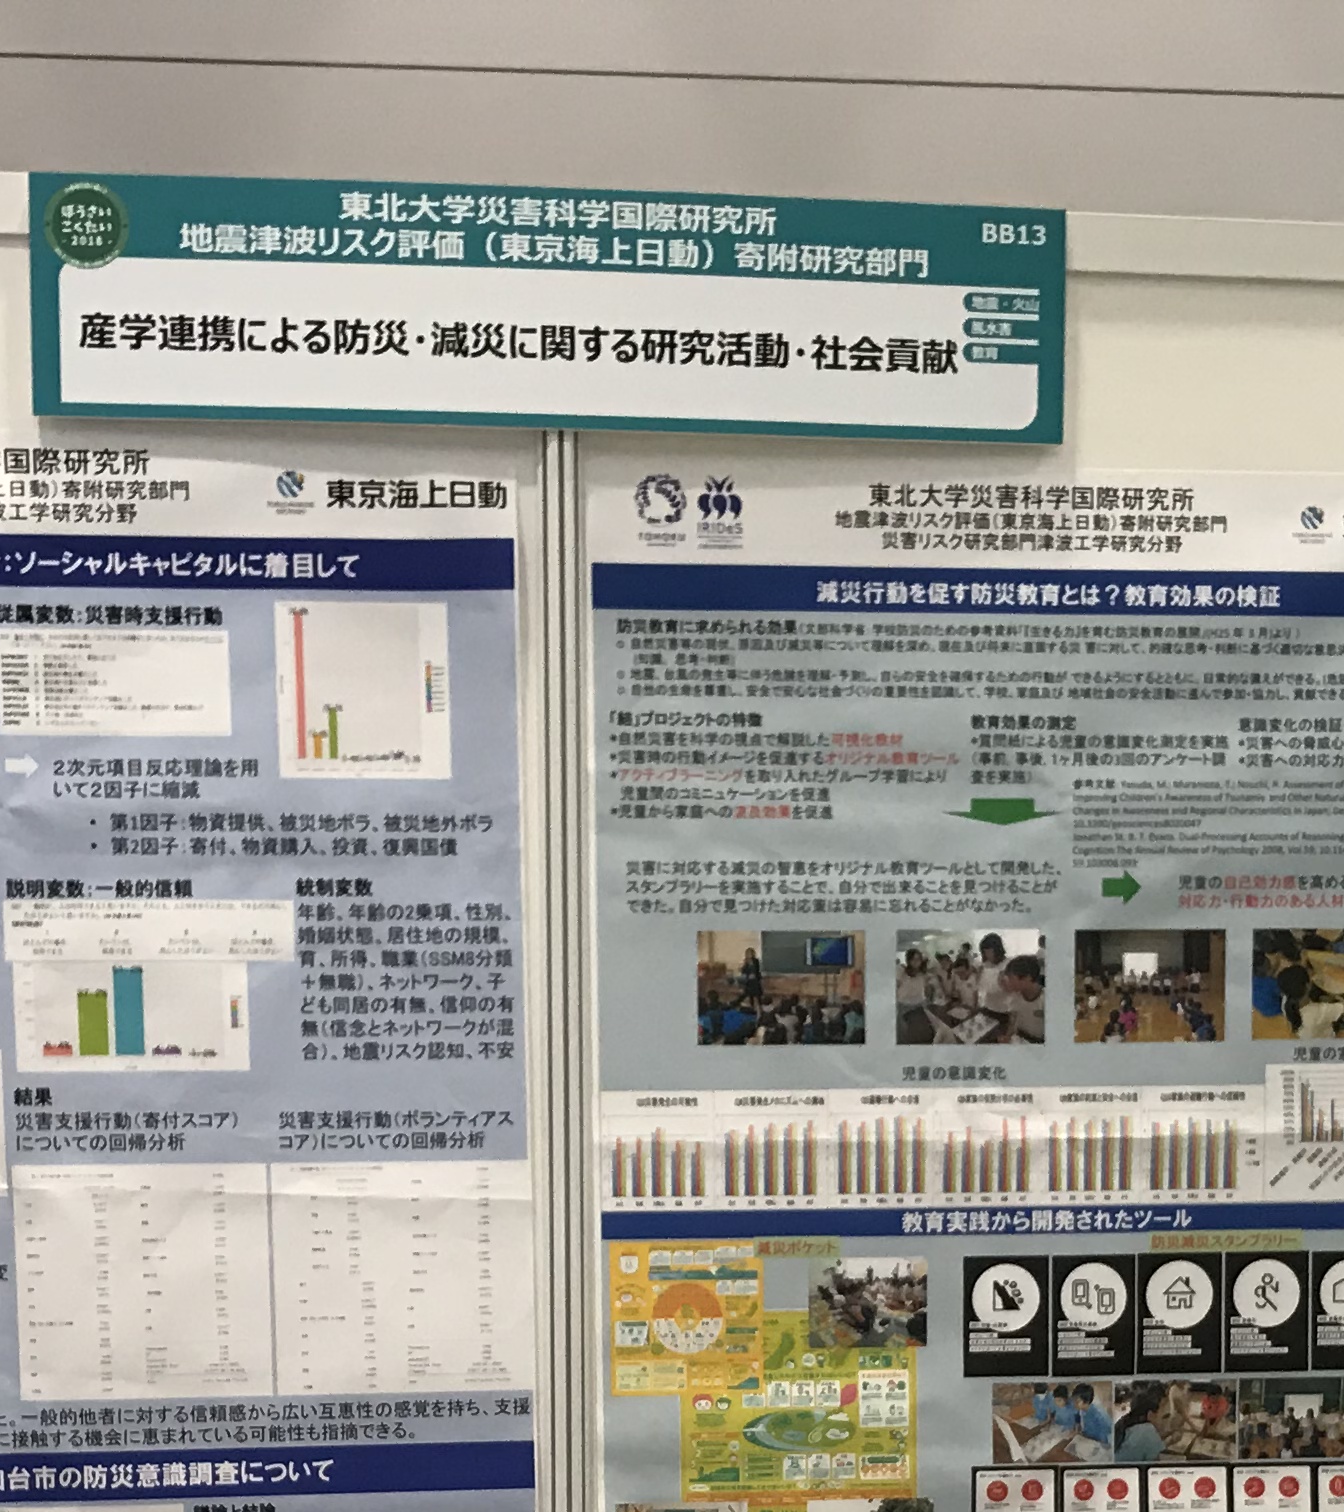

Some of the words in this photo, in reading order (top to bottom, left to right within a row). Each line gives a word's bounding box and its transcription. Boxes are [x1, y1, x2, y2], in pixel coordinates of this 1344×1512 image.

[338, 190, 778, 238] 東北大学災害科学国際研究所
[982, 223, 1047, 246] BB13
[179, 223, 930, 280] 地震津波リスク評価（東京海上日動）寄附研究部門
[78, 312, 959, 376] 産学連携による防災・減災に関する研究活動・社会貢献
[325, 478, 508, 510] 東京海上日動
[867, 483, 1195, 512] 東北大学災害科学国際研究所
[816, 580, 1282, 608] 減災行動を促す防災教育とは？教育効果の検証
[53, 758, 259, 779] 2次元項目反応理論を用
[295, 877, 373, 898] 統制変数
[16, 1132, 186, 1153] についての回帰分析
[902, 1210, 1192, 1233] 教育実践から開発されたツール
